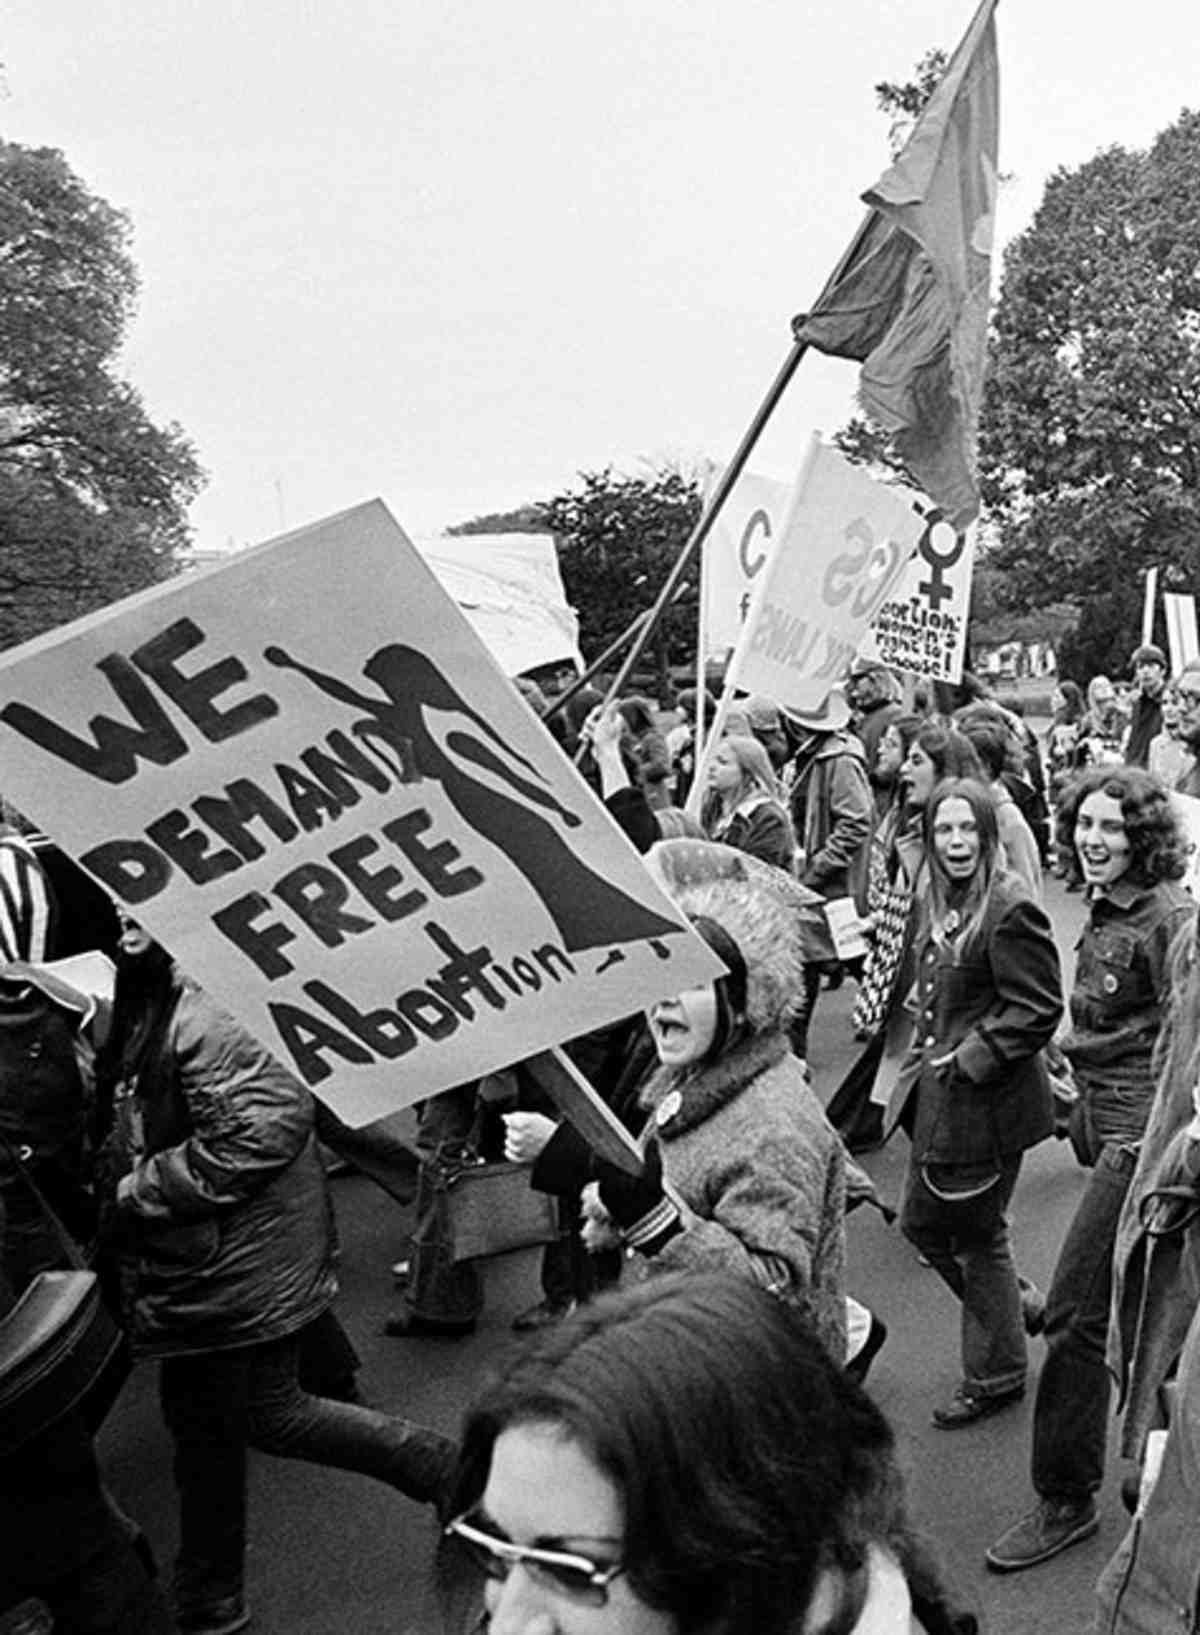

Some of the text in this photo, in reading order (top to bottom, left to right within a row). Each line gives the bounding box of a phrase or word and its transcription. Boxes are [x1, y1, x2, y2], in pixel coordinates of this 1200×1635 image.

[0, 616, 280, 785] WE
[79, 718, 422, 904] DEMAND
[211, 808, 485, 982] FREE
[267, 920, 577, 1086] Abortion
